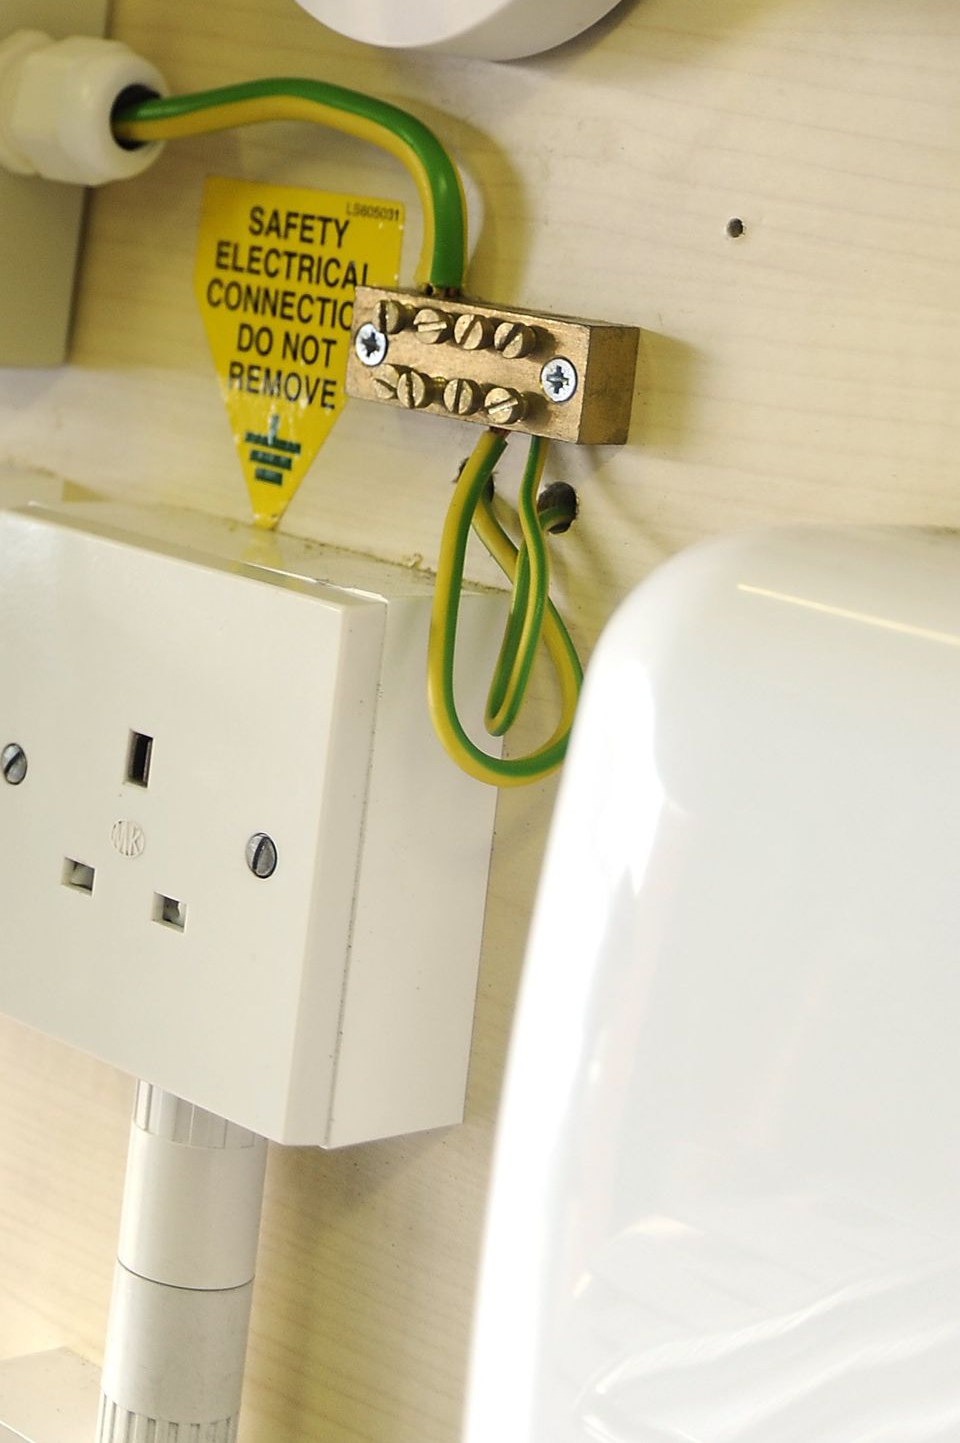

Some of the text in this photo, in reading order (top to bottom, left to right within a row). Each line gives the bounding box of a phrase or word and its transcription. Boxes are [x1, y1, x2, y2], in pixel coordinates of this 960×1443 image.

[249, 205, 350, 249] SAFETY
[215, 240, 369, 290] ELECTRICAL
[207, 277, 354, 332] CONNECTIO
[237, 323, 337, 369] DO NOT
[227, 360, 337, 410] REMOVE
